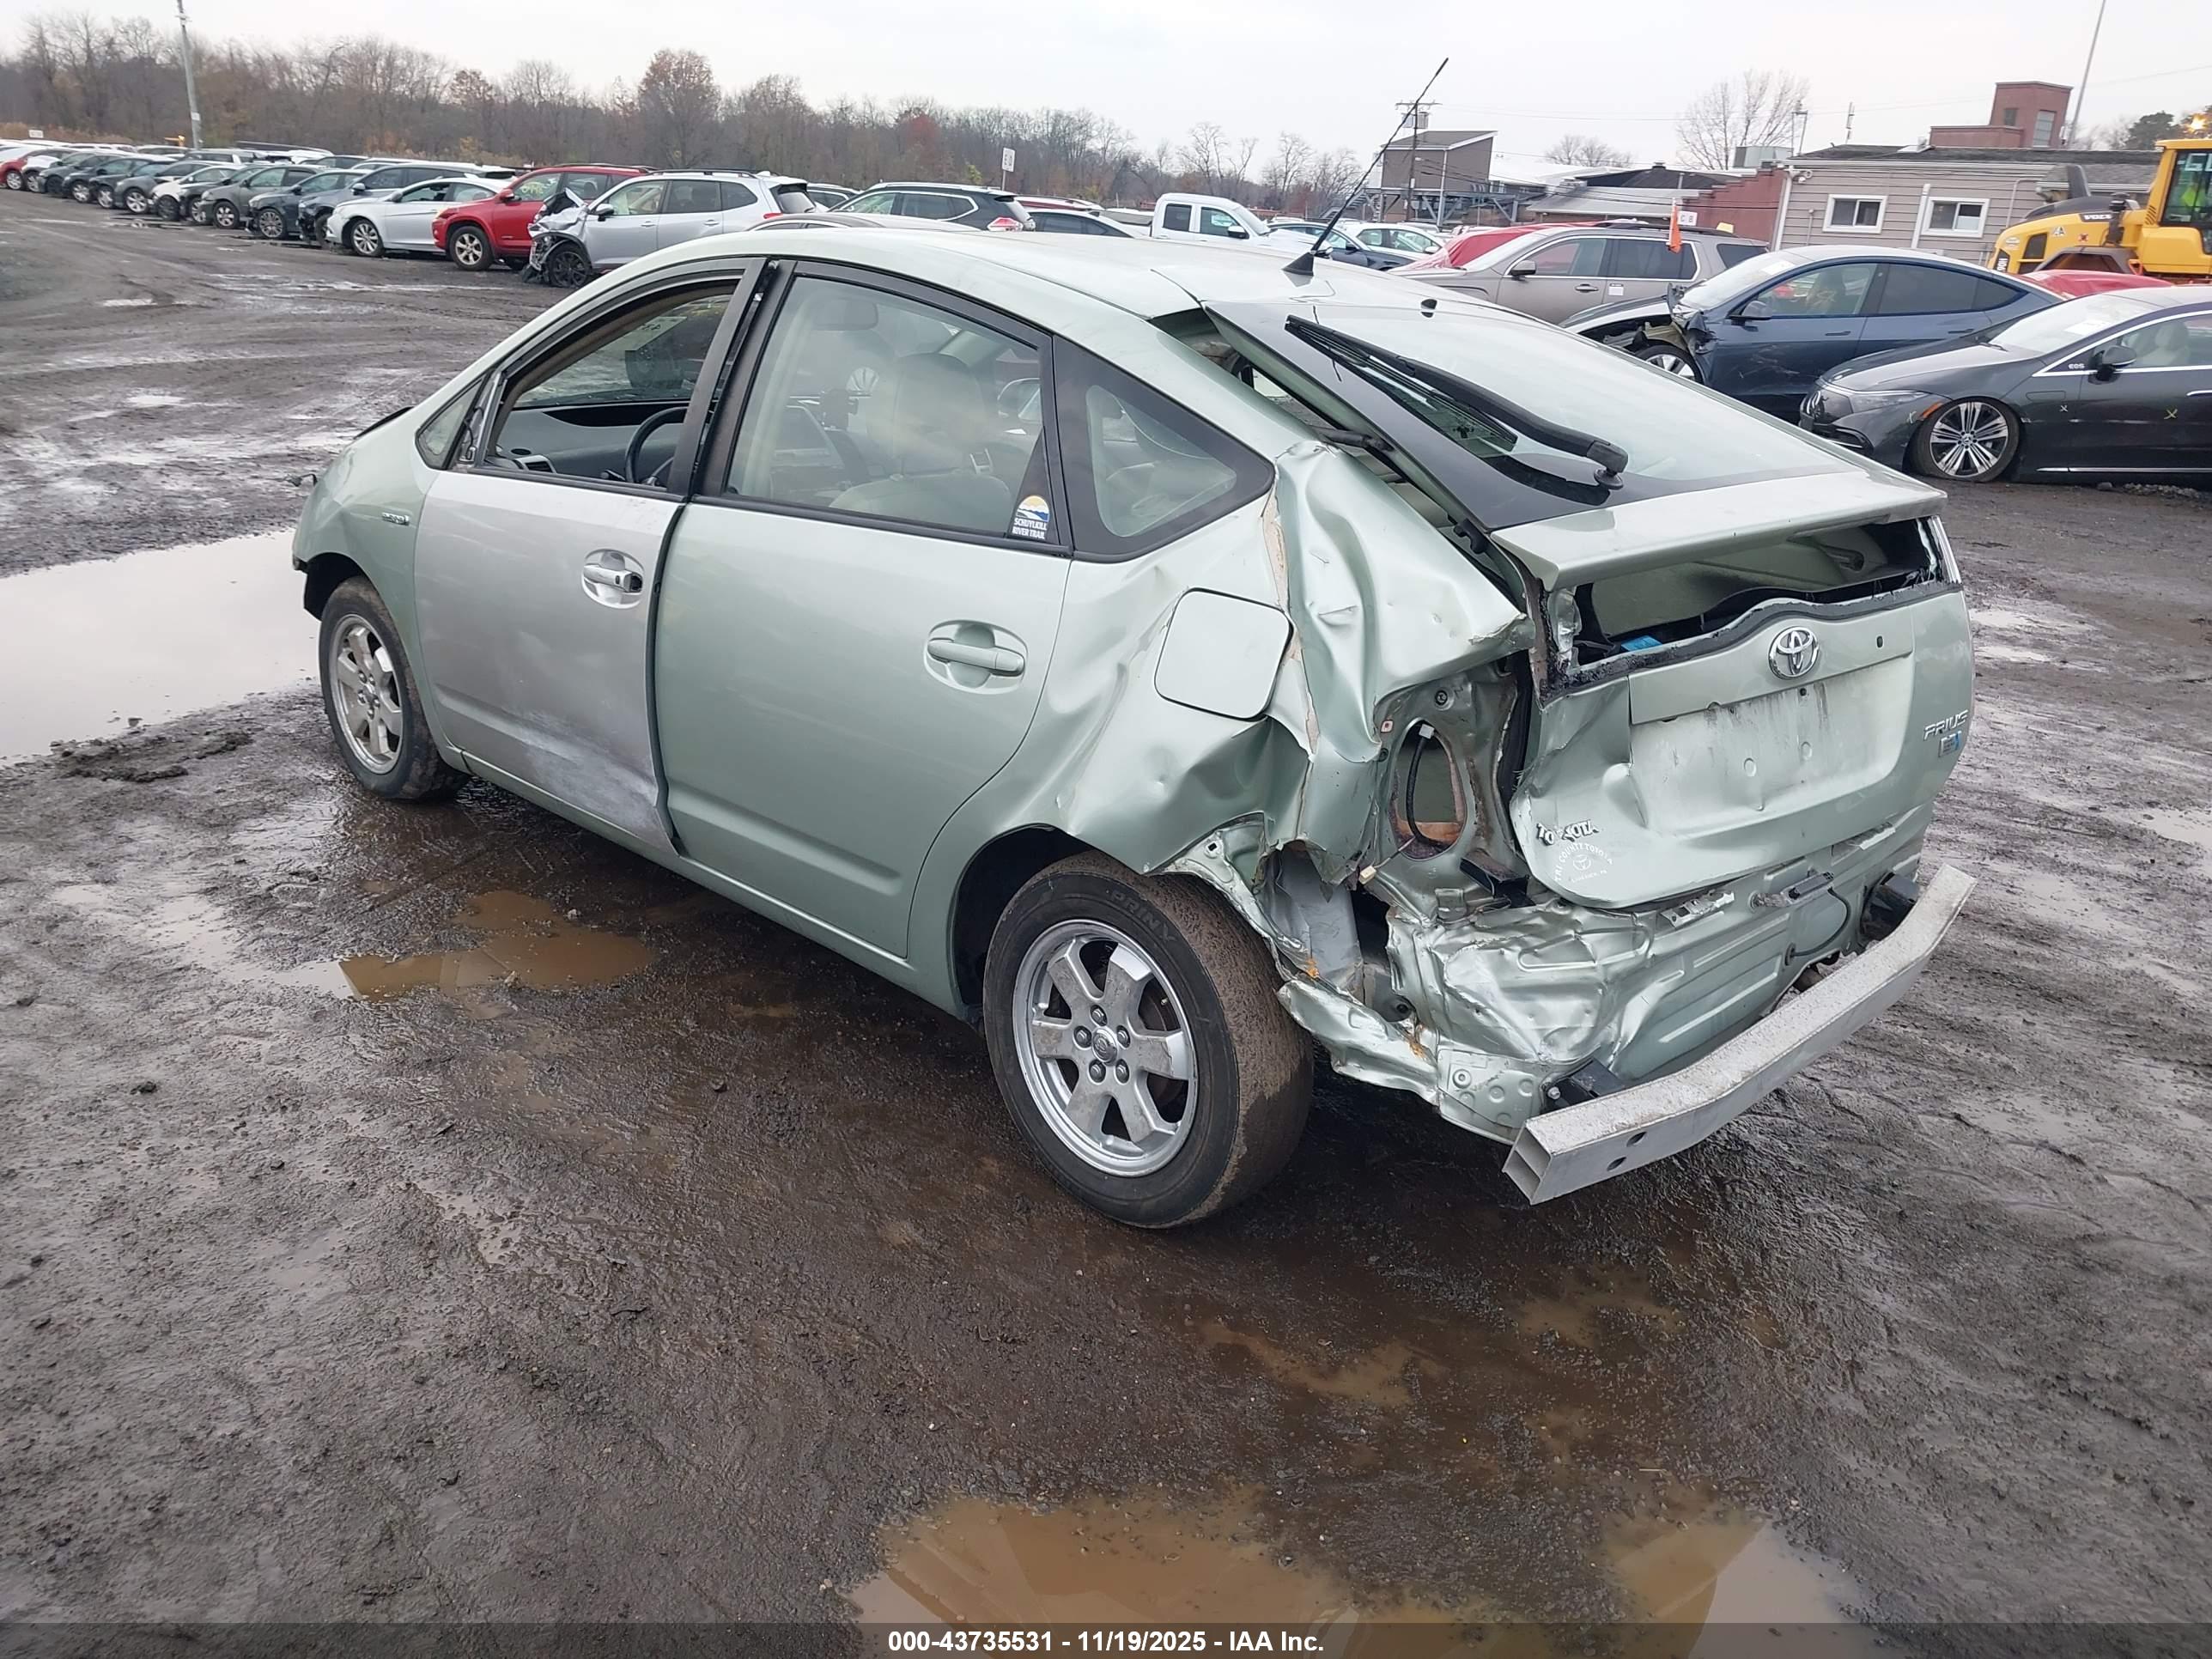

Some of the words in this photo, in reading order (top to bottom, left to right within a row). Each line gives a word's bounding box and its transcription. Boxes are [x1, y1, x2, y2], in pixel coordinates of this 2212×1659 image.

[1012, 526, 1029, 537] RIVER
[1030, 528, 1045, 540] TRAIL
[1923, 708, 1969, 741] PRIUS
[1559, 842, 1583, 863] COUNTY
[1111, 890, 1178, 944] PRINX
